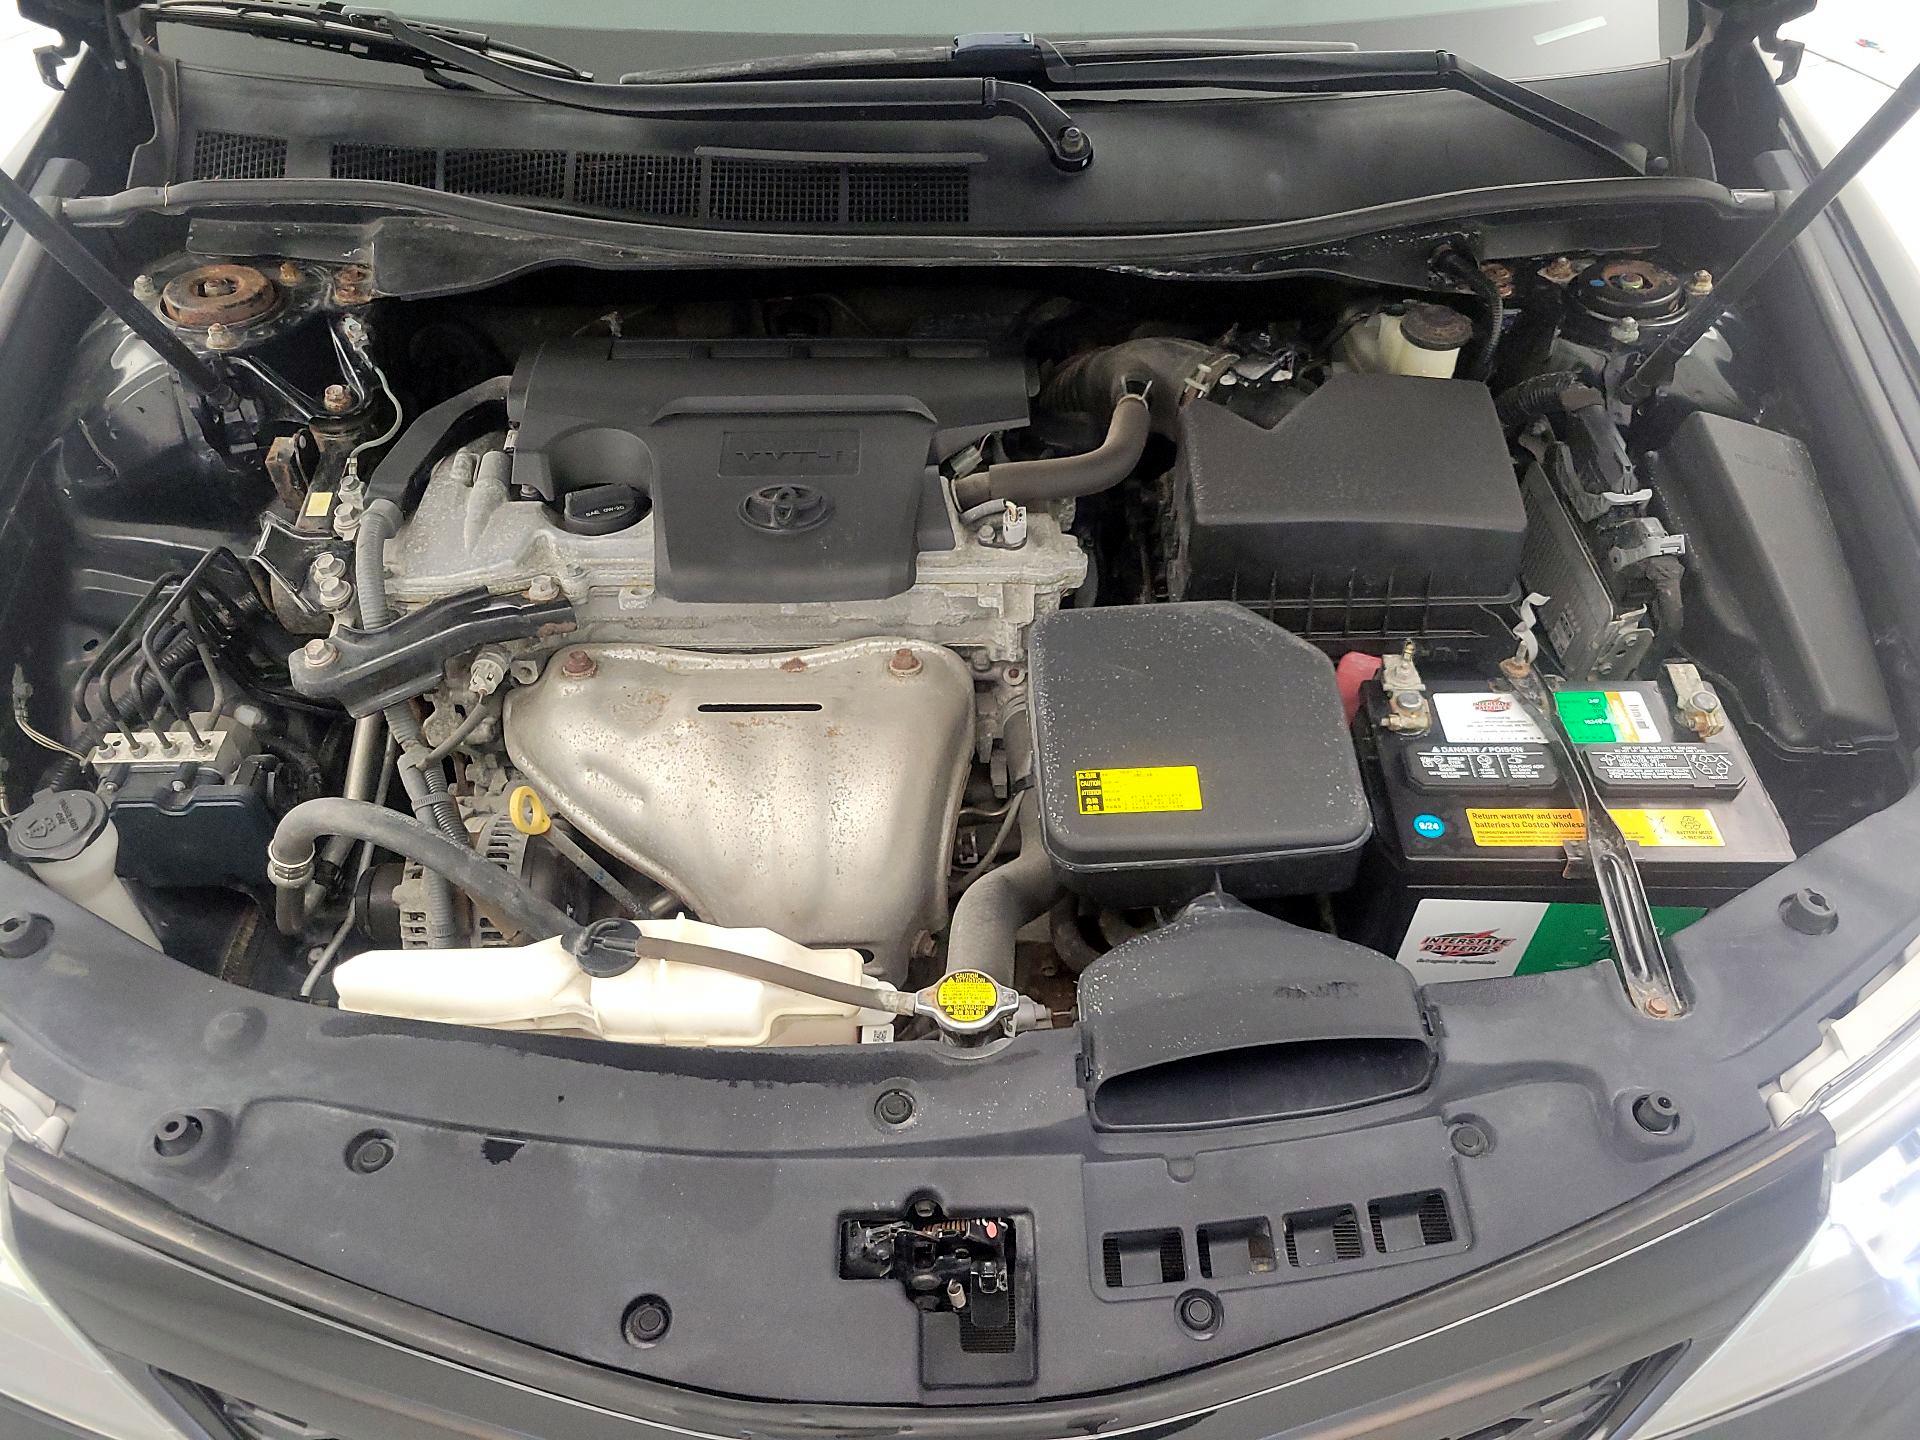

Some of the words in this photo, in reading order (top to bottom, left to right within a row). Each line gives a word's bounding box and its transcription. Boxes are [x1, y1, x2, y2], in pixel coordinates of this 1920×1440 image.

[585, 509, 601, 517] SAE
[602, 505, 625, 513] 0W-20
[1472, 812, 1499, 820] Return
[1501, 813, 1534, 821] warranty
[1536, 812, 1551, 820] and
[1552, 812, 1573, 820] used
[1475, 821, 1511, 829] batteries
[1512, 821, 1521, 829] to
[1521, 821, 1550, 829] Costco
[1551, 821, 1585, 829] Wholesa
[1423, 937, 1512, 946] INTERSTATE
[1423, 944, 1500, 953] BATTERIES
